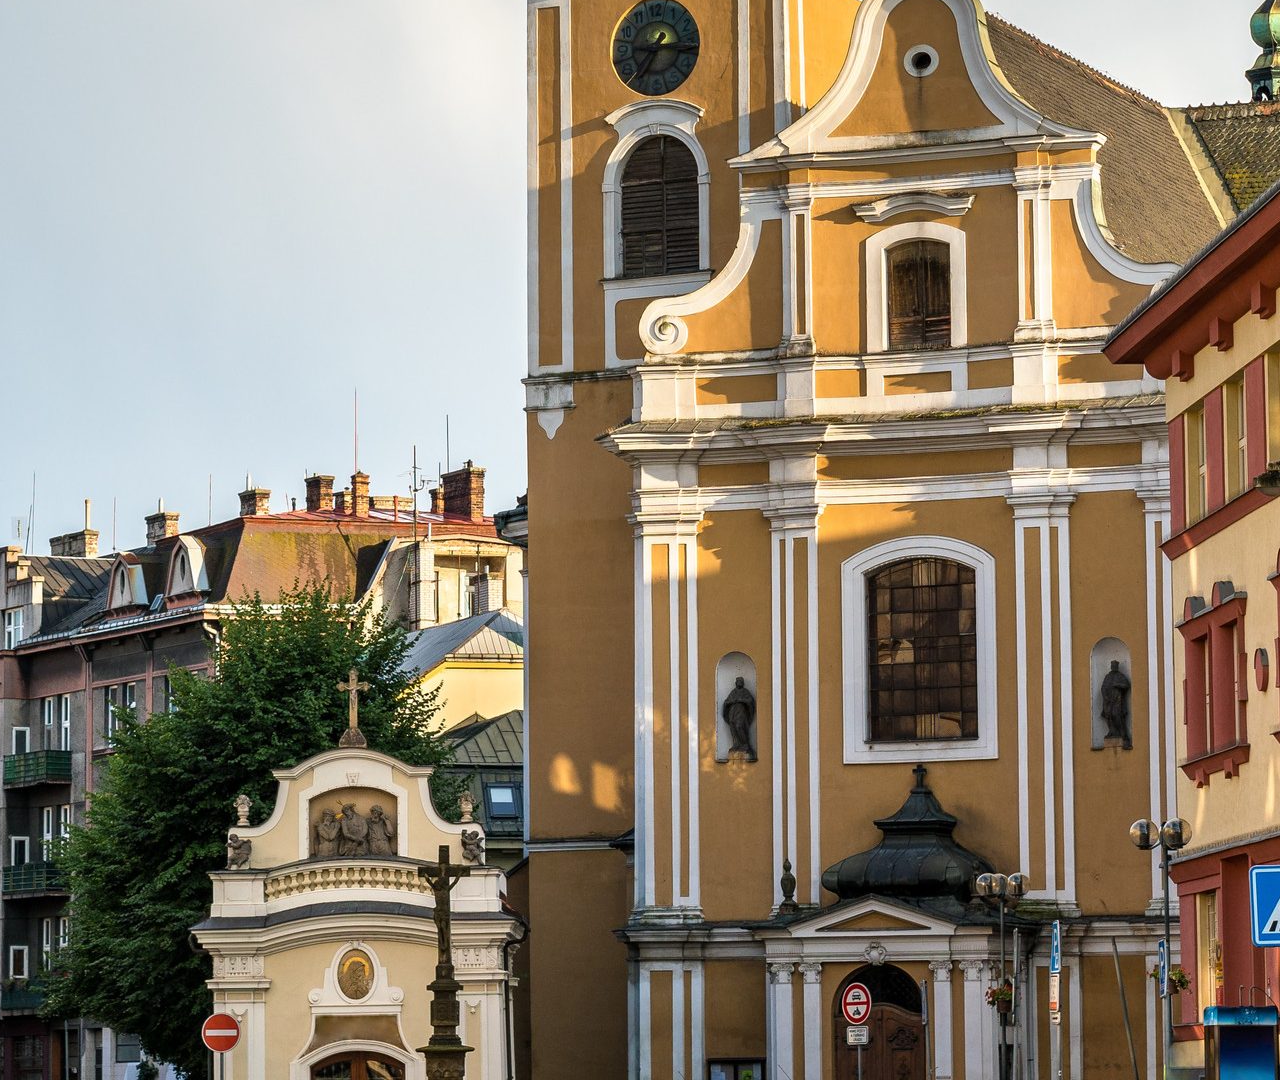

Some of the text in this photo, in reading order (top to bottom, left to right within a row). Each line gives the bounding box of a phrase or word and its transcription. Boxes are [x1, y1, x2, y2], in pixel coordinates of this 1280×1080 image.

[649, 3, 662, 17] 12
[670, 7, 676, 18] 1
[633, 10, 643, 24] 11
[683, 19, 691, 32] 2
[621, 26, 632, 39] 10
[617, 45, 628, 57] 9
